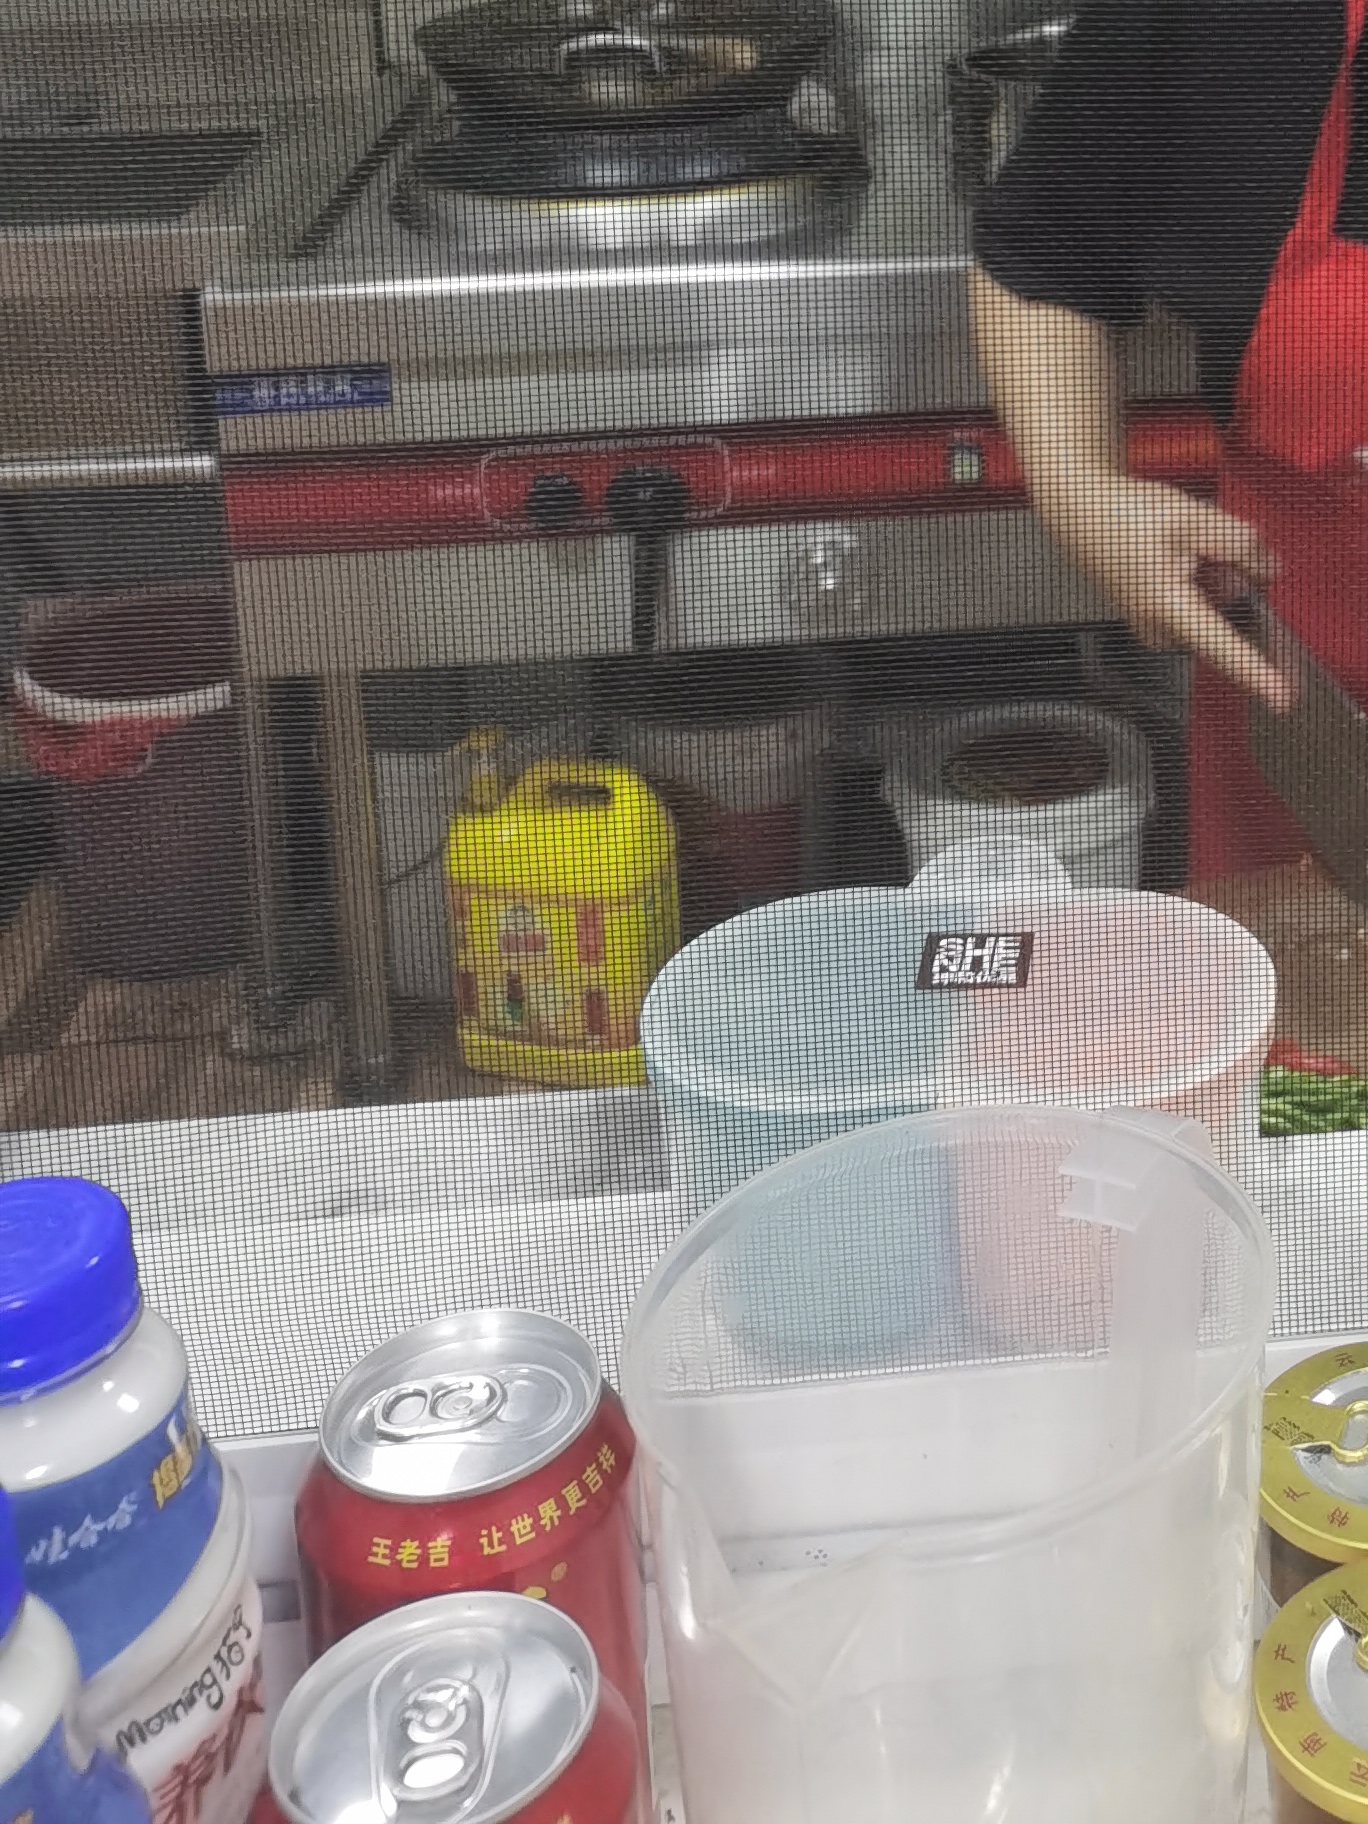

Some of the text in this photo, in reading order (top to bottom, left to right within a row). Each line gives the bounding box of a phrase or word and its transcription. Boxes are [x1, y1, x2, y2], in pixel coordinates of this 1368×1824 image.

[367, 1443, 617, 1569] 王老吉 让世界更吉祥
[115, 1666, 224, 1765] Morning
